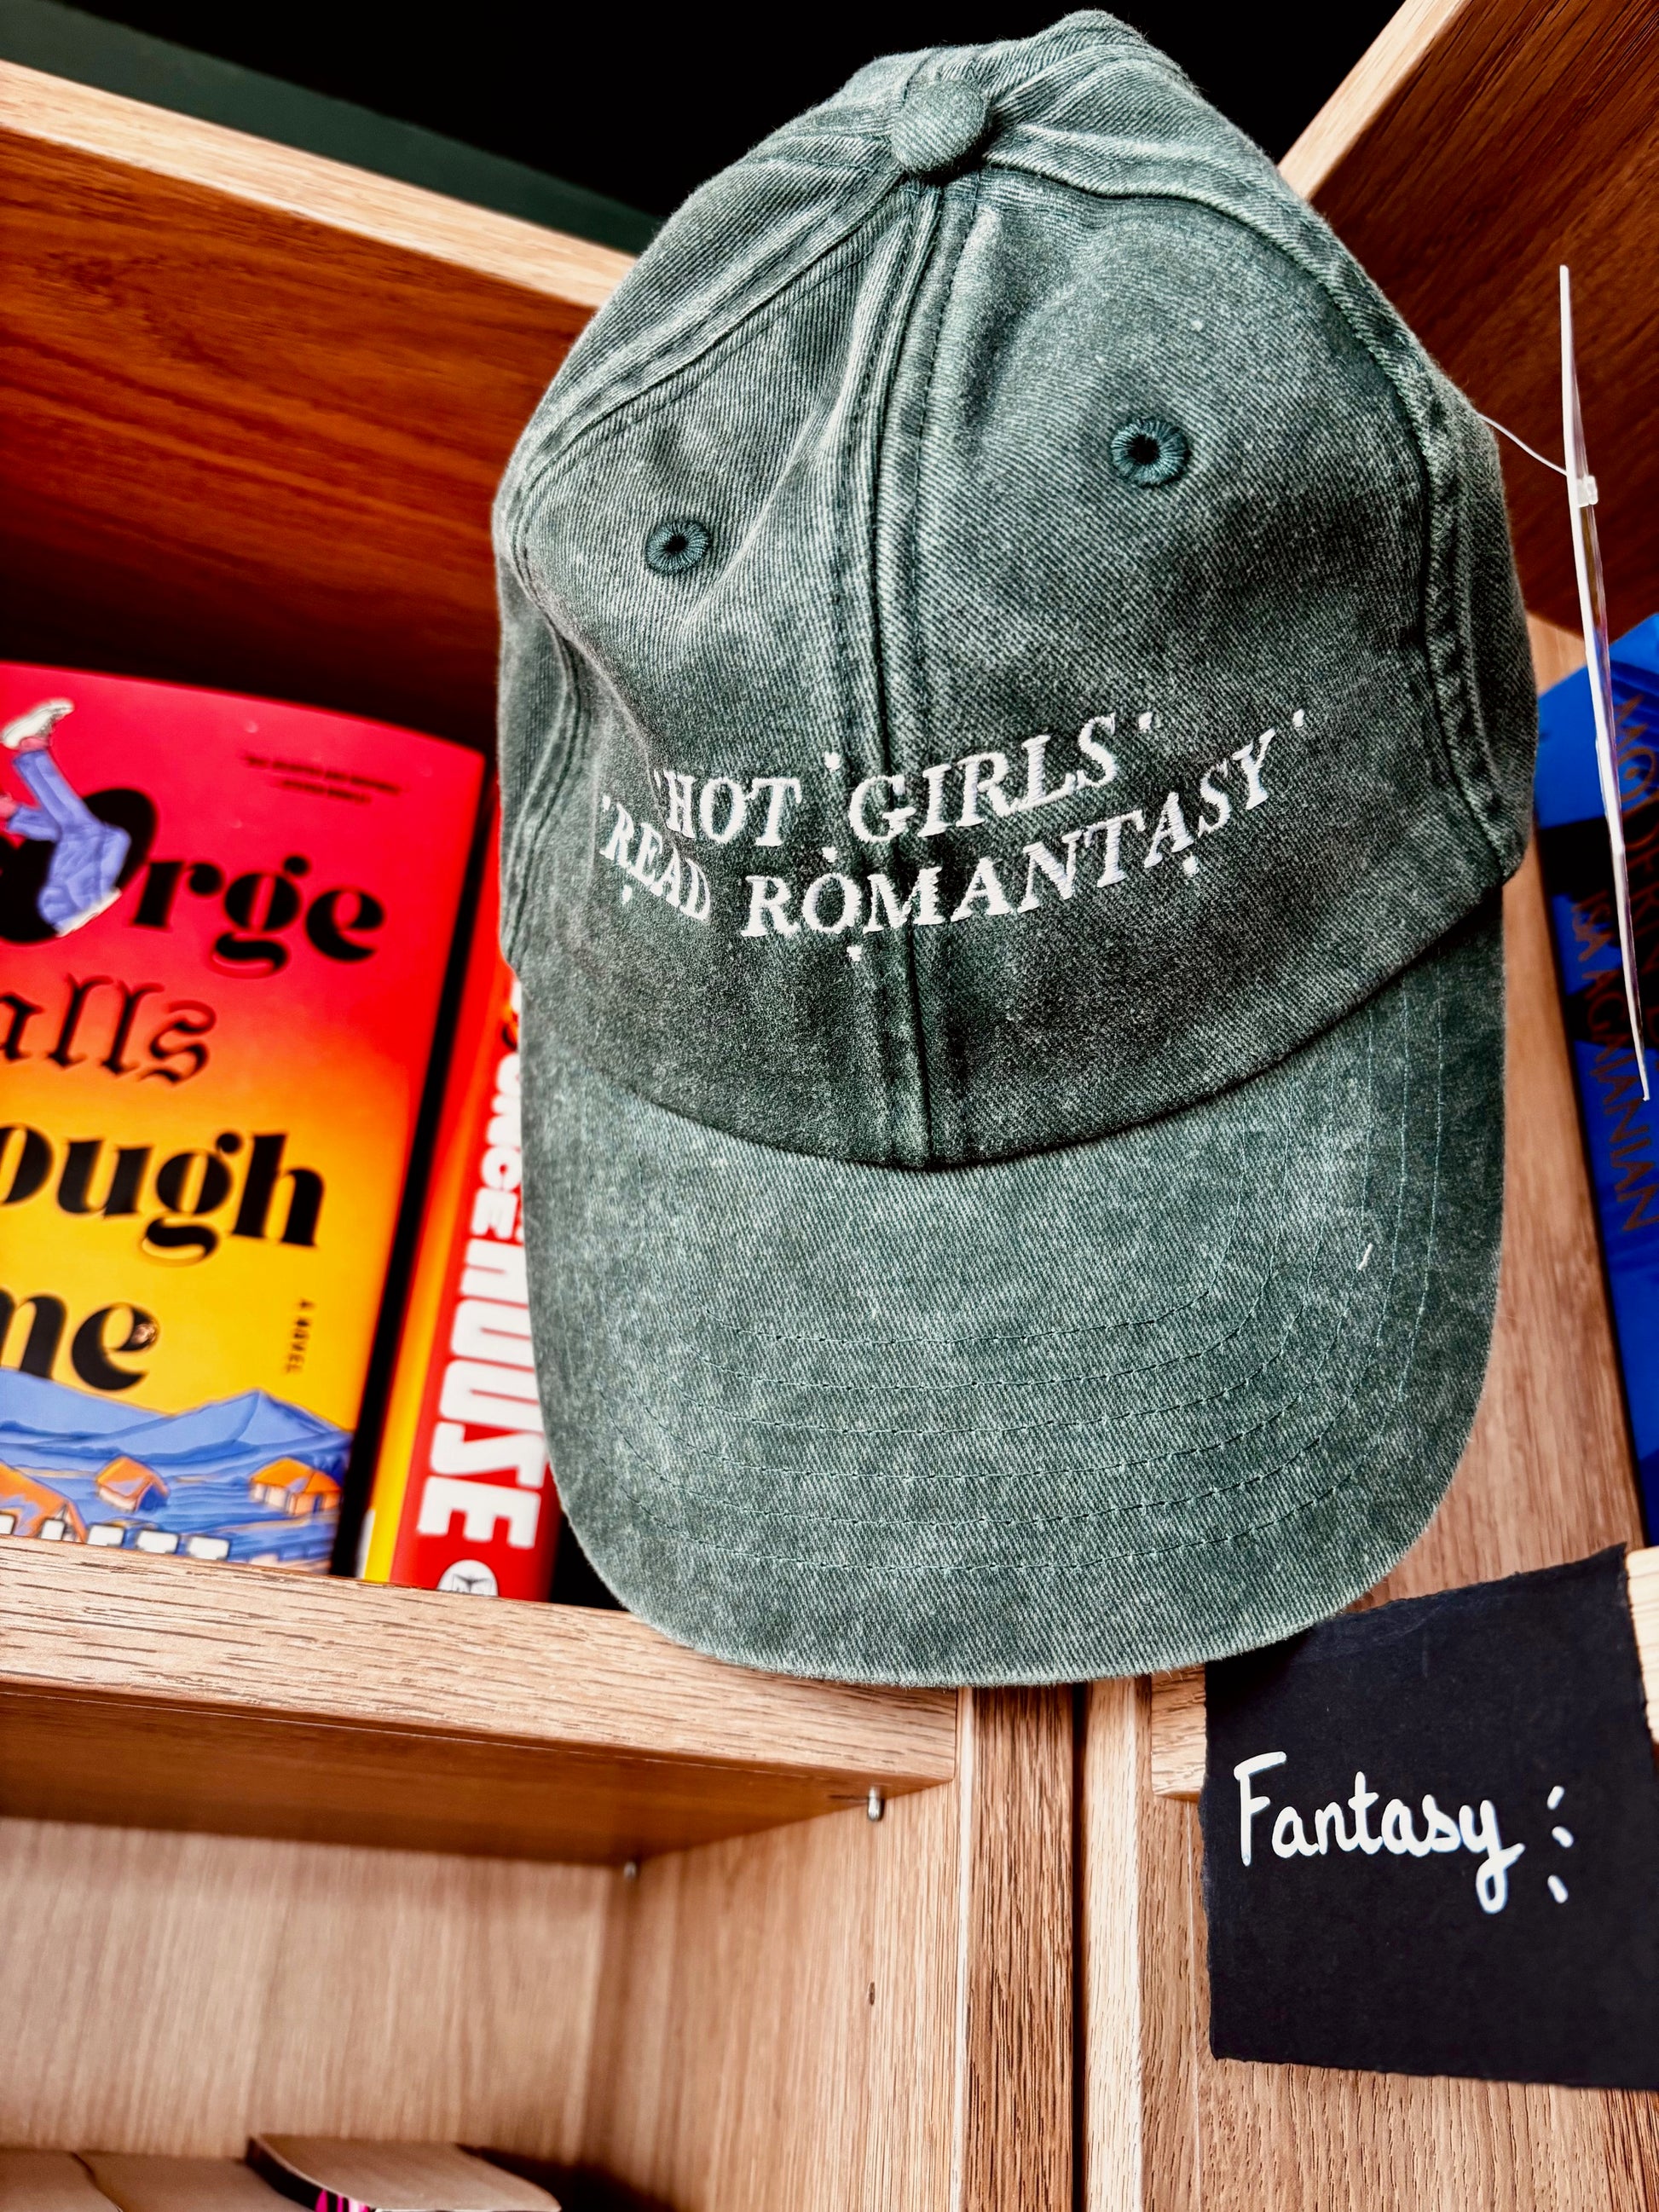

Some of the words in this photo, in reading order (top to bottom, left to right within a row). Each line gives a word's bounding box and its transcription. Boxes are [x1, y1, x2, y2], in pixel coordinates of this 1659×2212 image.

[598, 802, 712, 923] READ
[740, 728, 1277, 939] ROMANTASY
[662, 768, 803, 847] HOT
[847, 712, 1117, 843] GIRLS
[1233, 1750, 1526, 1915] Fantasy
